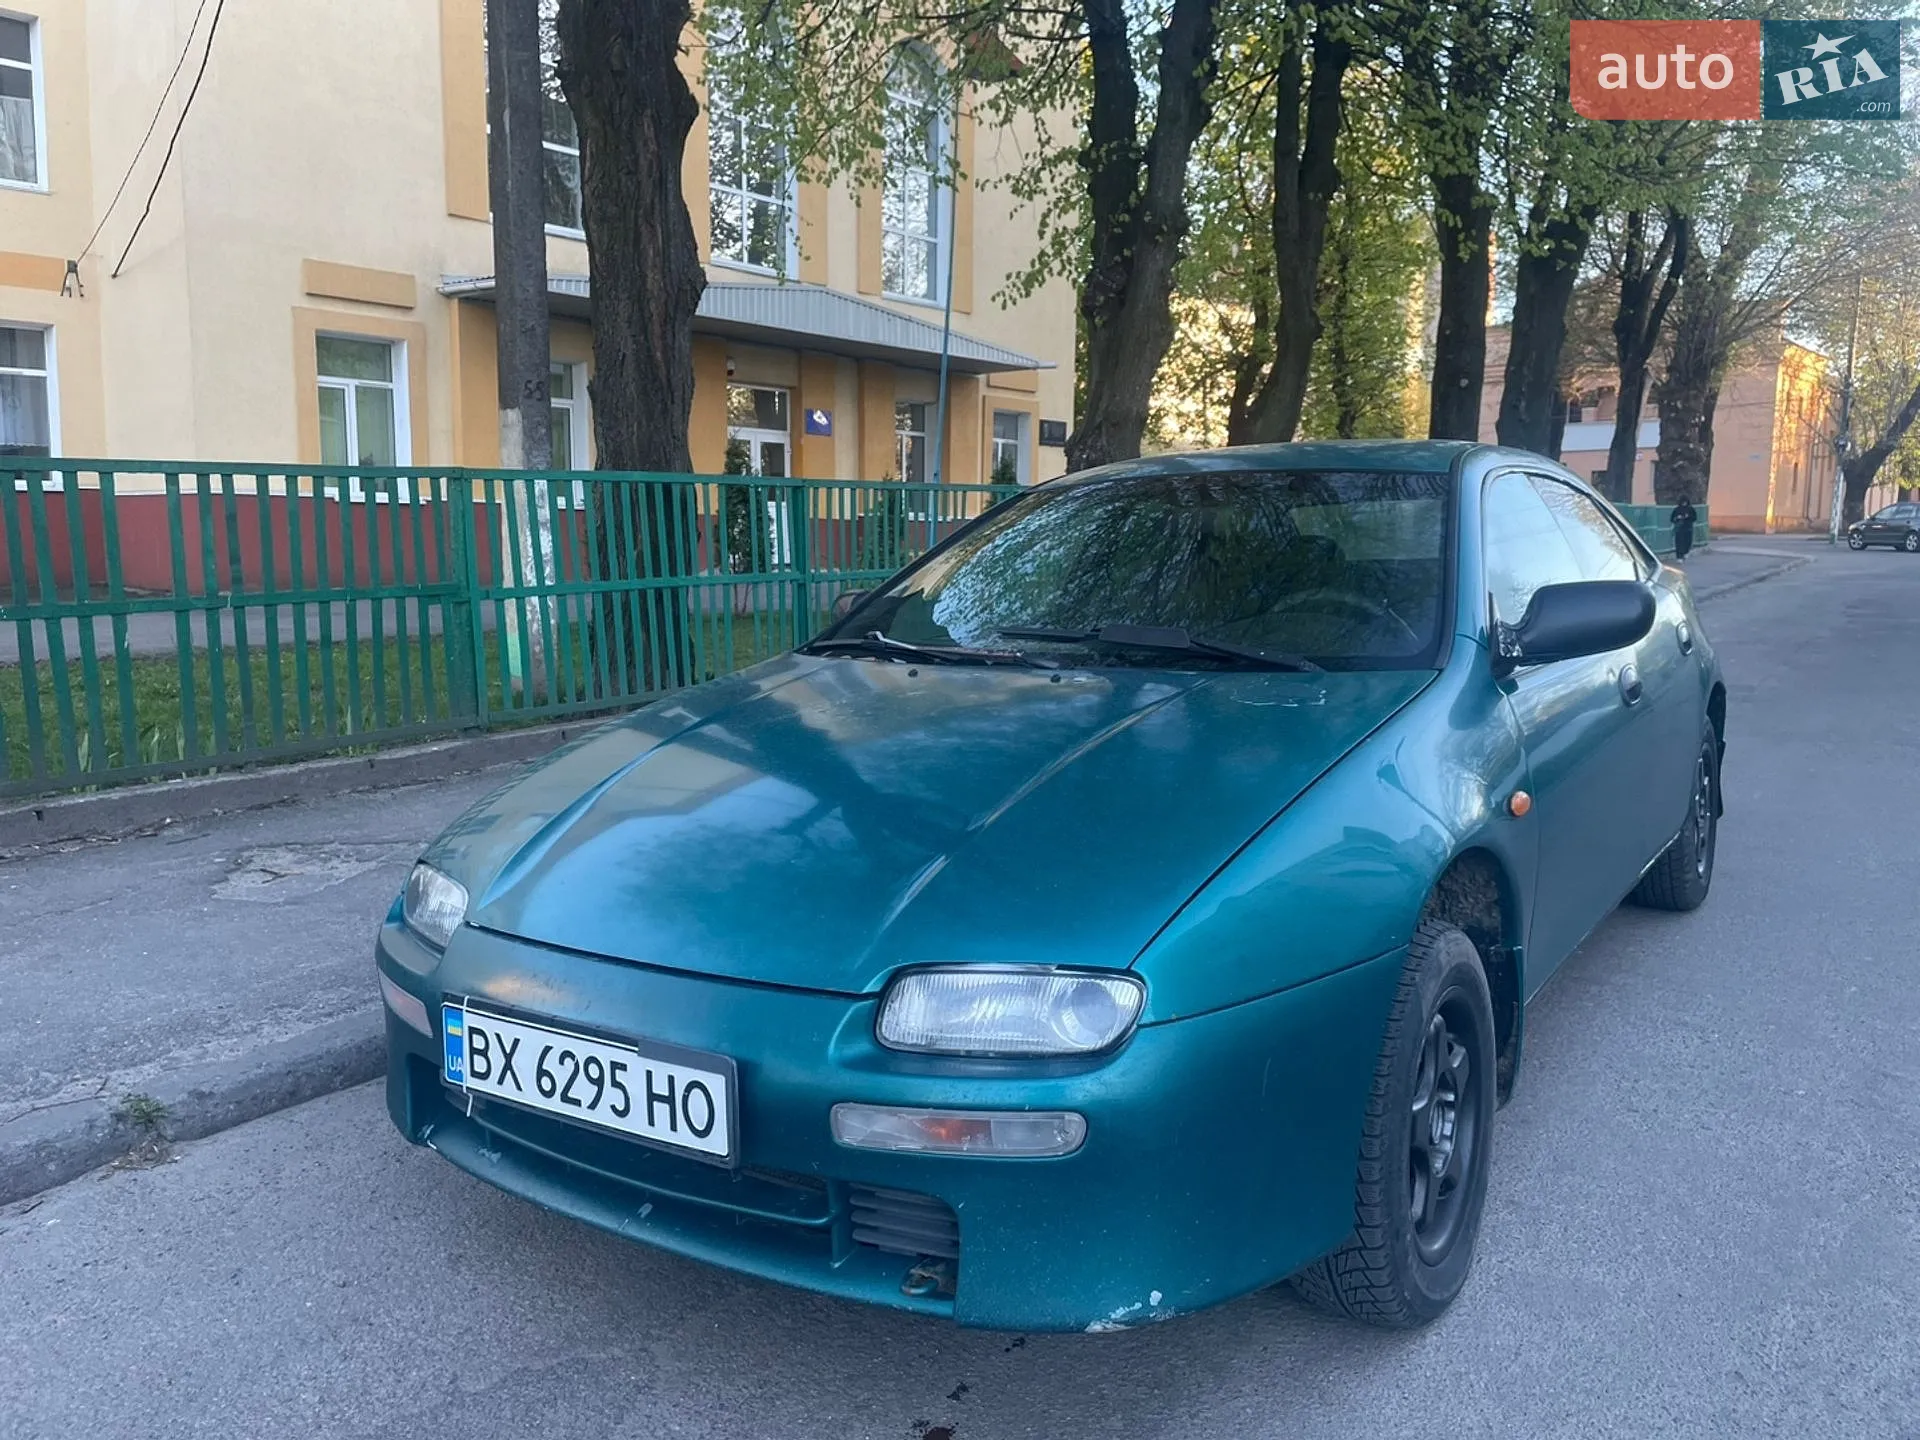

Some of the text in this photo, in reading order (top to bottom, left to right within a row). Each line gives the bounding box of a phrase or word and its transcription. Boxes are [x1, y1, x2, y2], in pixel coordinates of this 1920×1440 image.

[448, 1054, 465, 1073] UA
[467, 1025, 715, 1139] BX 6295 HO
